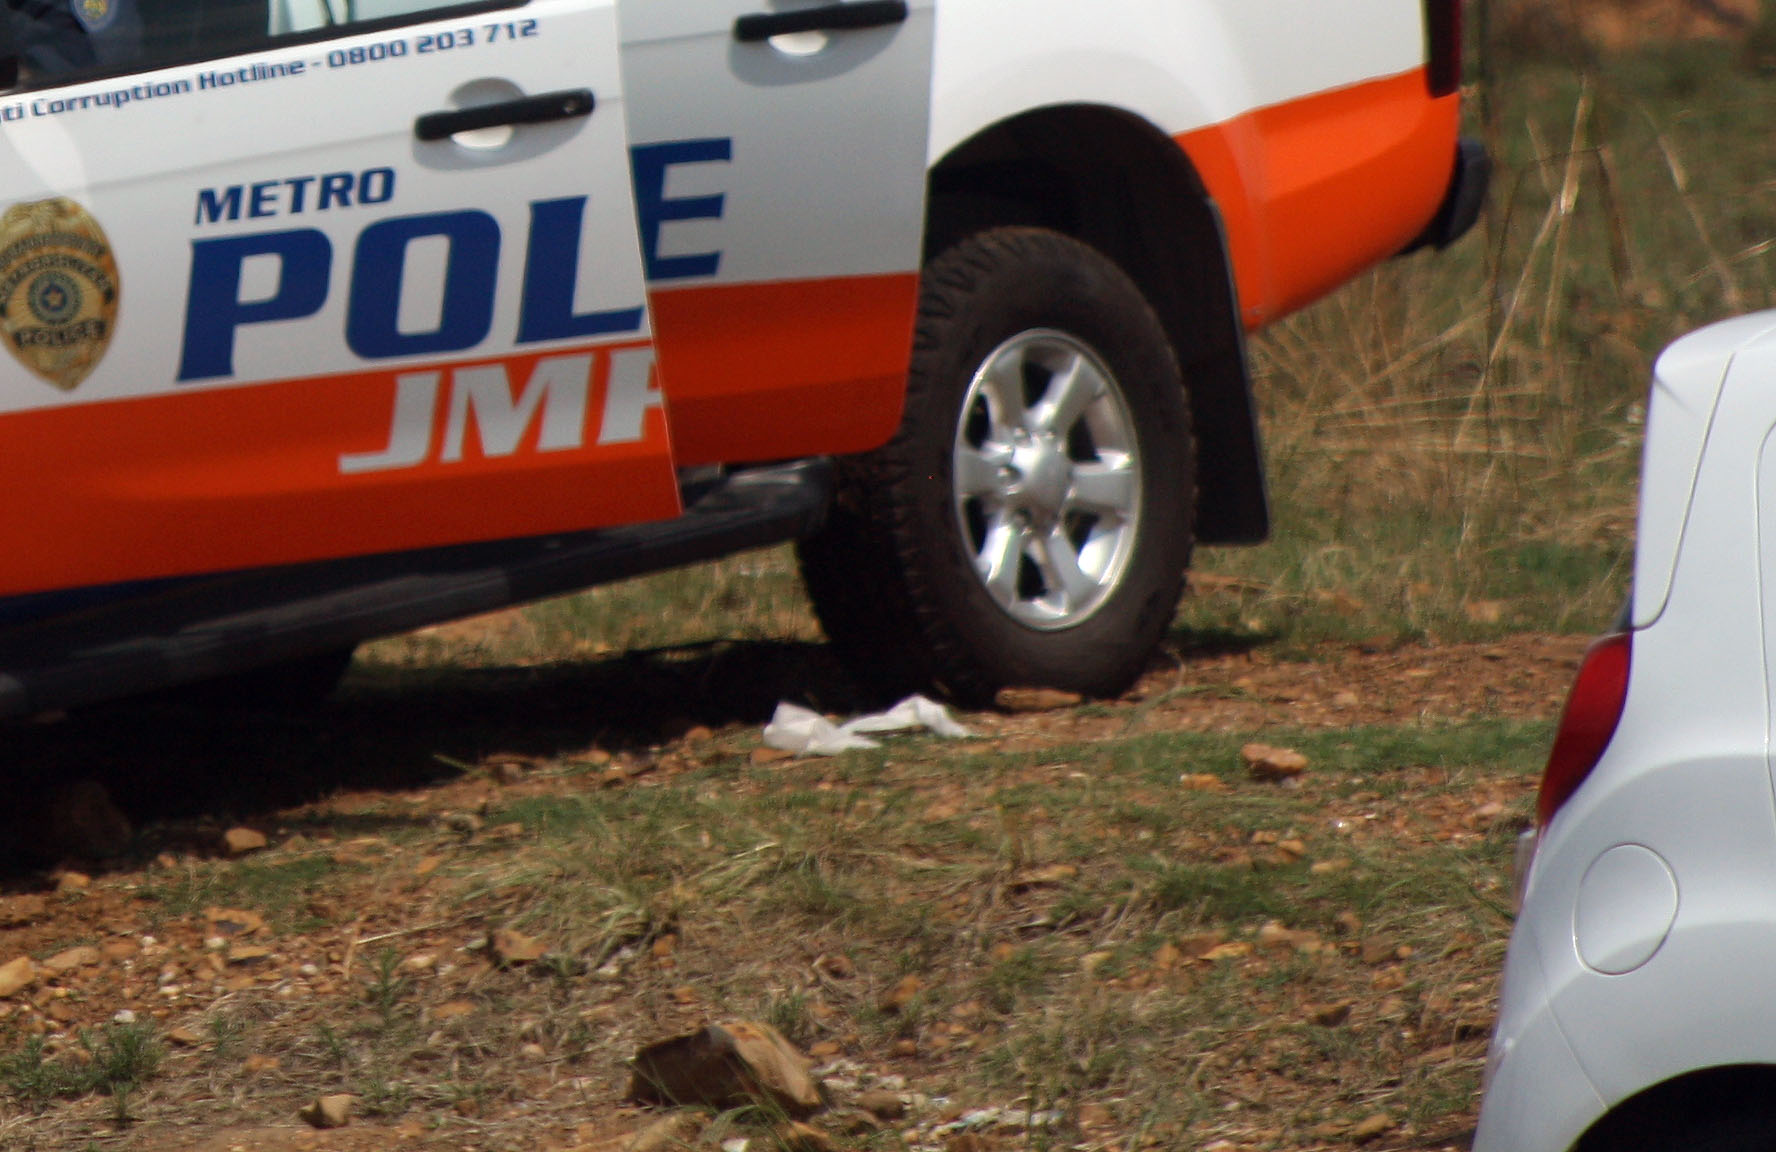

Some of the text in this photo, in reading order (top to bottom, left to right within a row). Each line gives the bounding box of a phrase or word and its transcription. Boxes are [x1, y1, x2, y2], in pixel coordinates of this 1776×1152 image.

[30, 78, 191, 117] Corruption
[198, 58, 305, 90] Hotline
[328, 40, 408, 69] 0800
[415, 29, 475, 53] 203
[483, 19, 539, 43] 712
[195, 166, 396, 226] METRO
